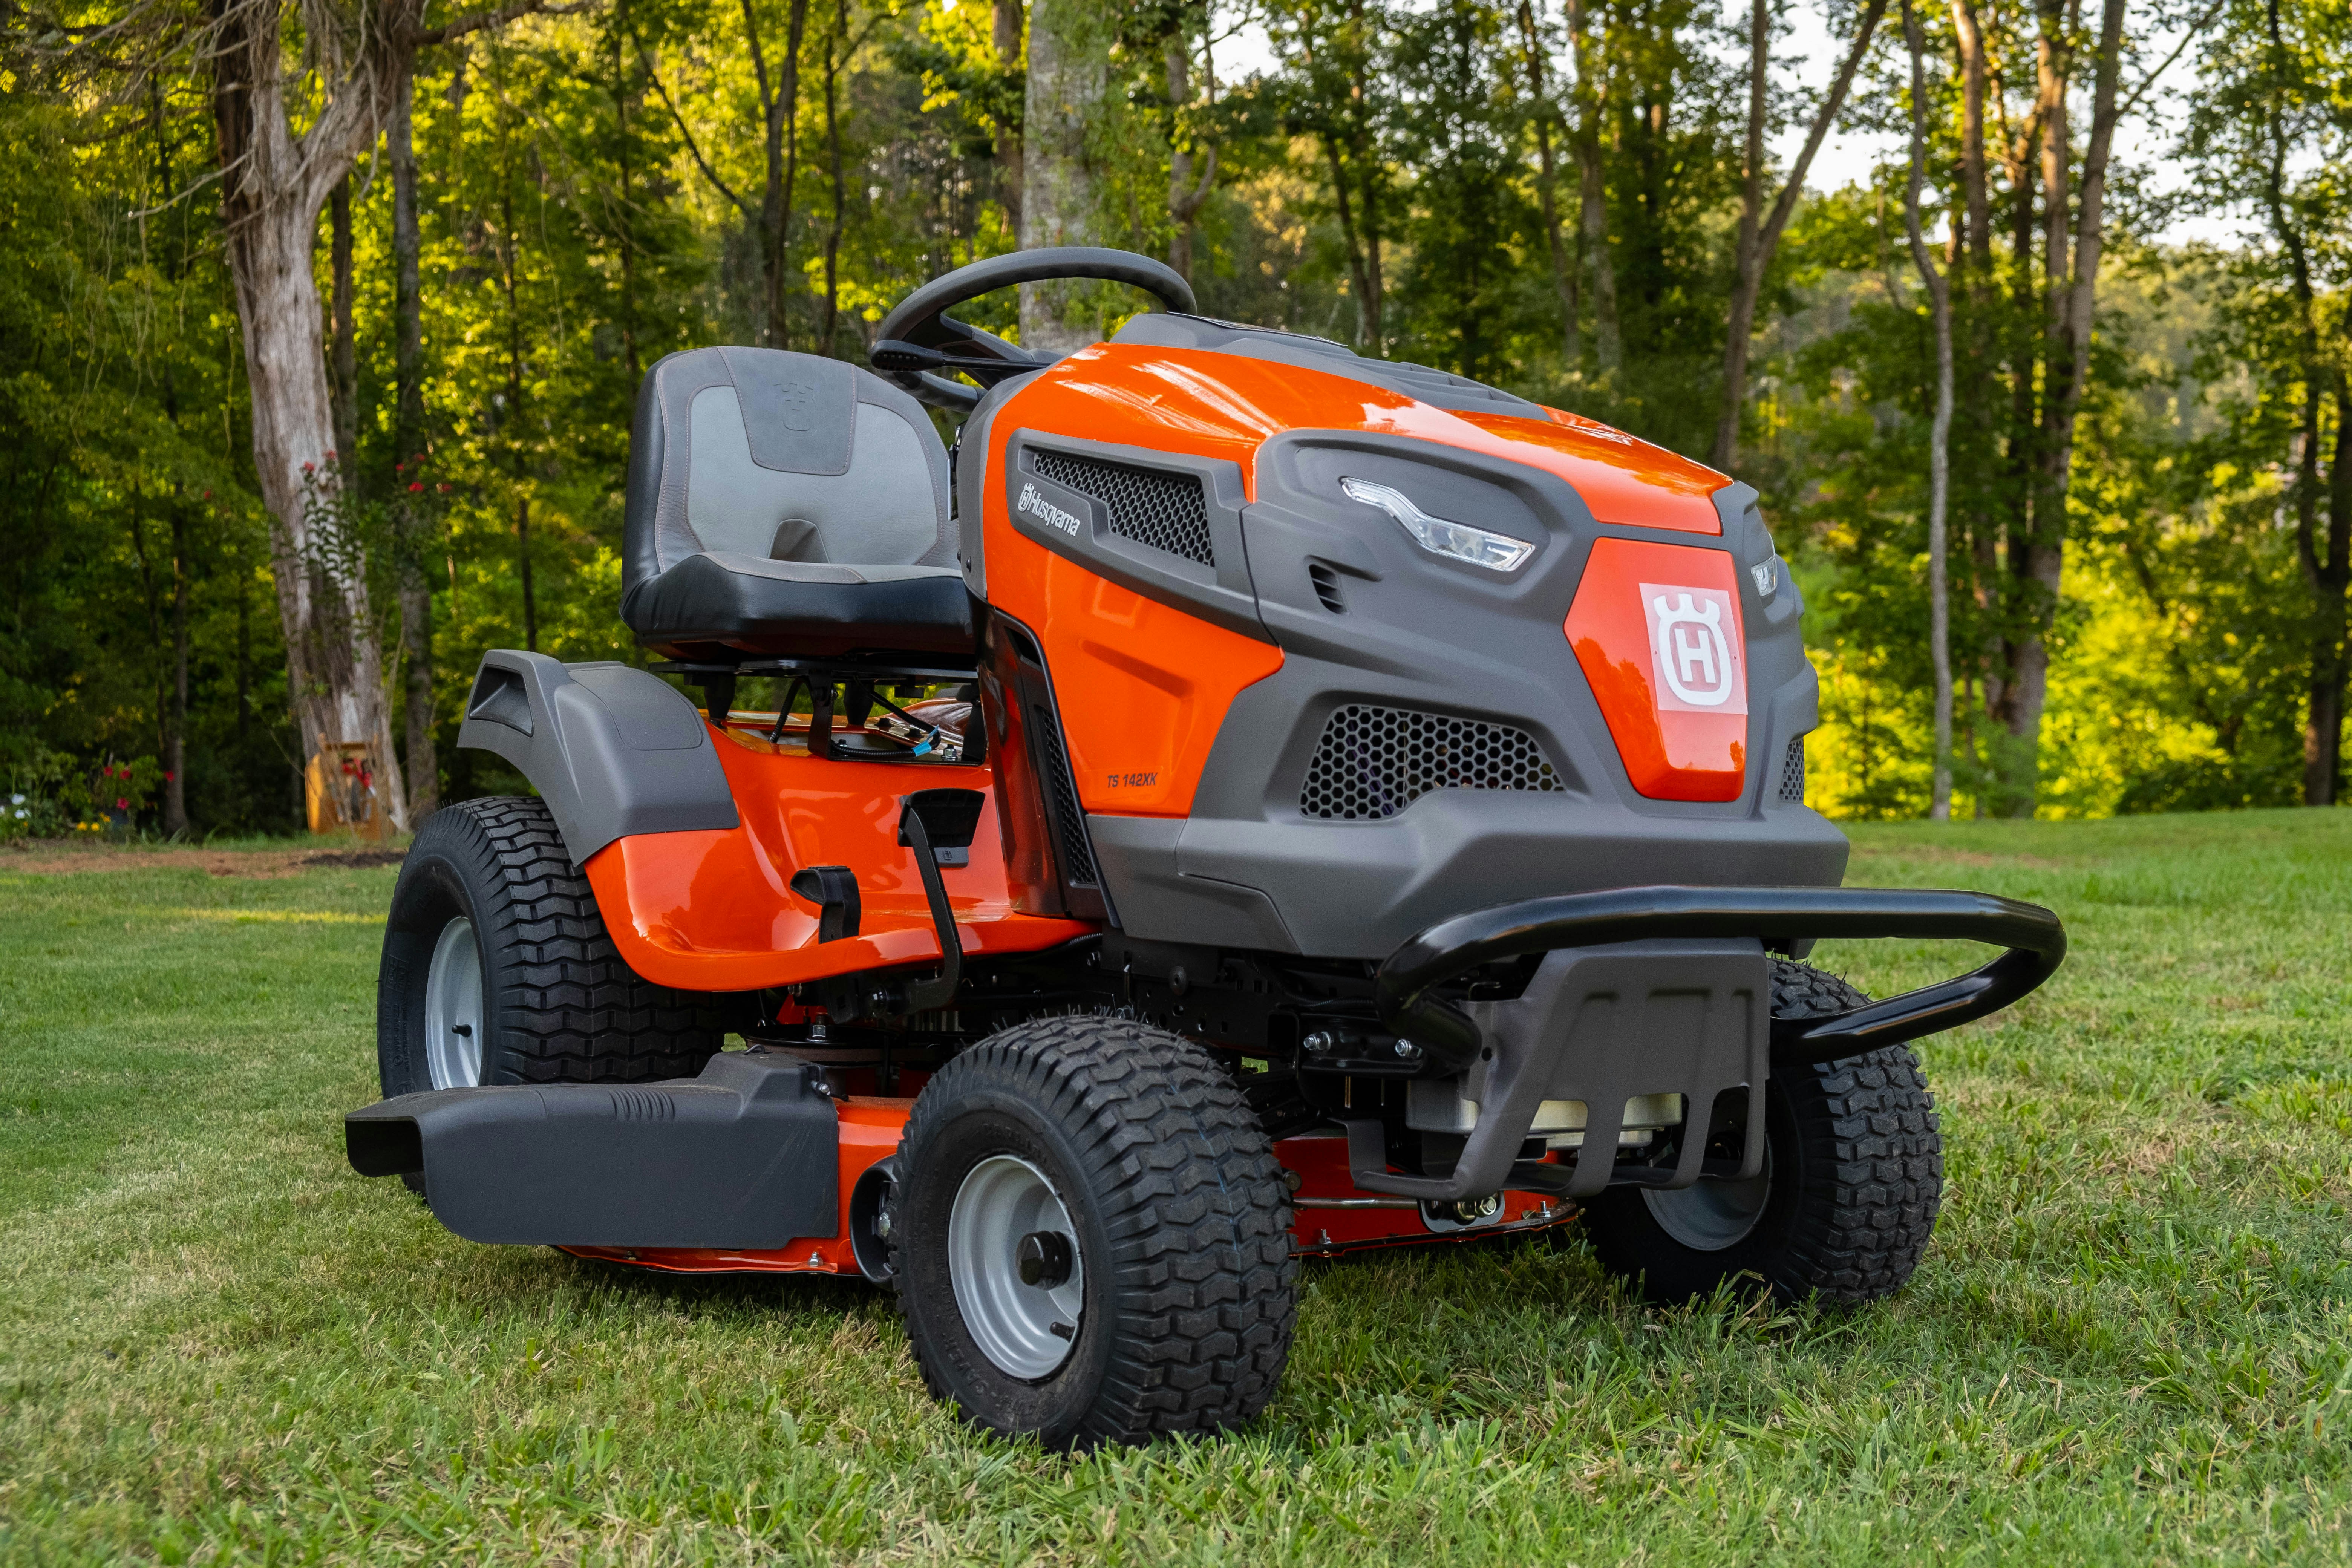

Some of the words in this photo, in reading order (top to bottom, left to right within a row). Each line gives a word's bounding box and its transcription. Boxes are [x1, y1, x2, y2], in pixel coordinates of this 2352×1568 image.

[1027, 490, 1080, 536] Husqvarna
[1107, 774, 1119, 788] TS
[1123, 772, 1158, 787] 142XK
